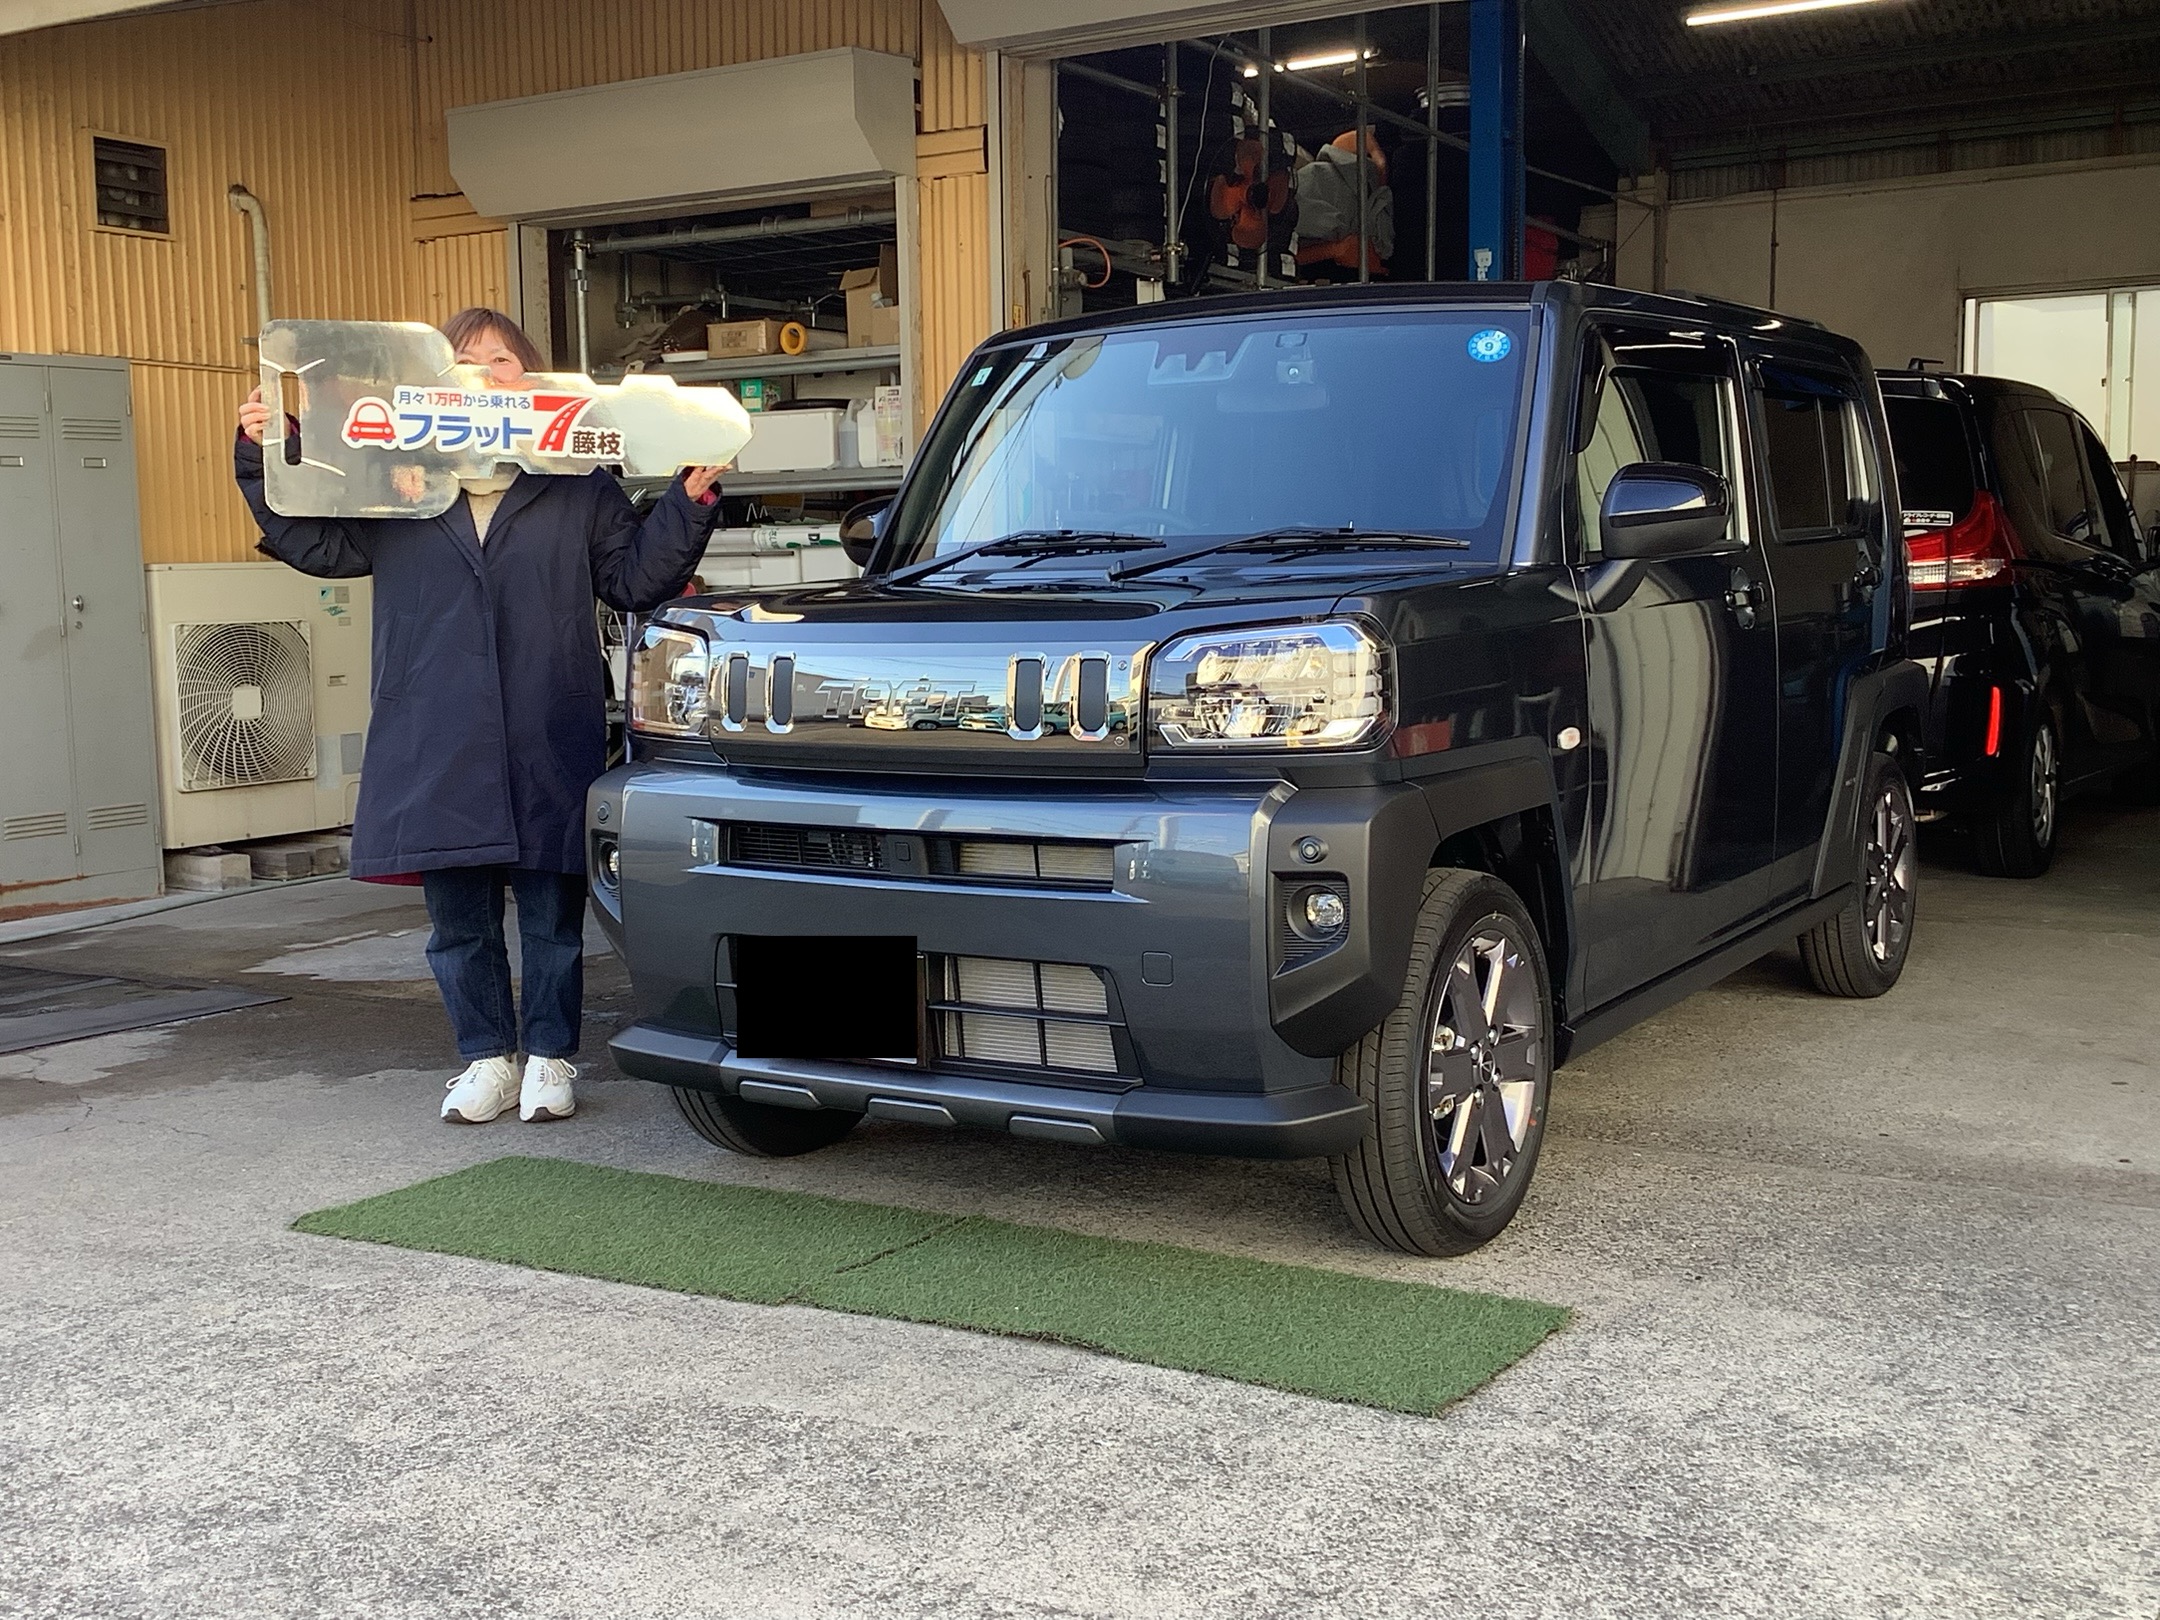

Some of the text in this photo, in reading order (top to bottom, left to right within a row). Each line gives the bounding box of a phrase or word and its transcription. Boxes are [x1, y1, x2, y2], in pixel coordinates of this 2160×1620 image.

[1484, 341, 1494, 351] 9
[398, 391, 531, 410] 月々1万円から乗れる
[572, 430, 621, 455] 藤枝
[815, 680, 977, 720] TAFT
